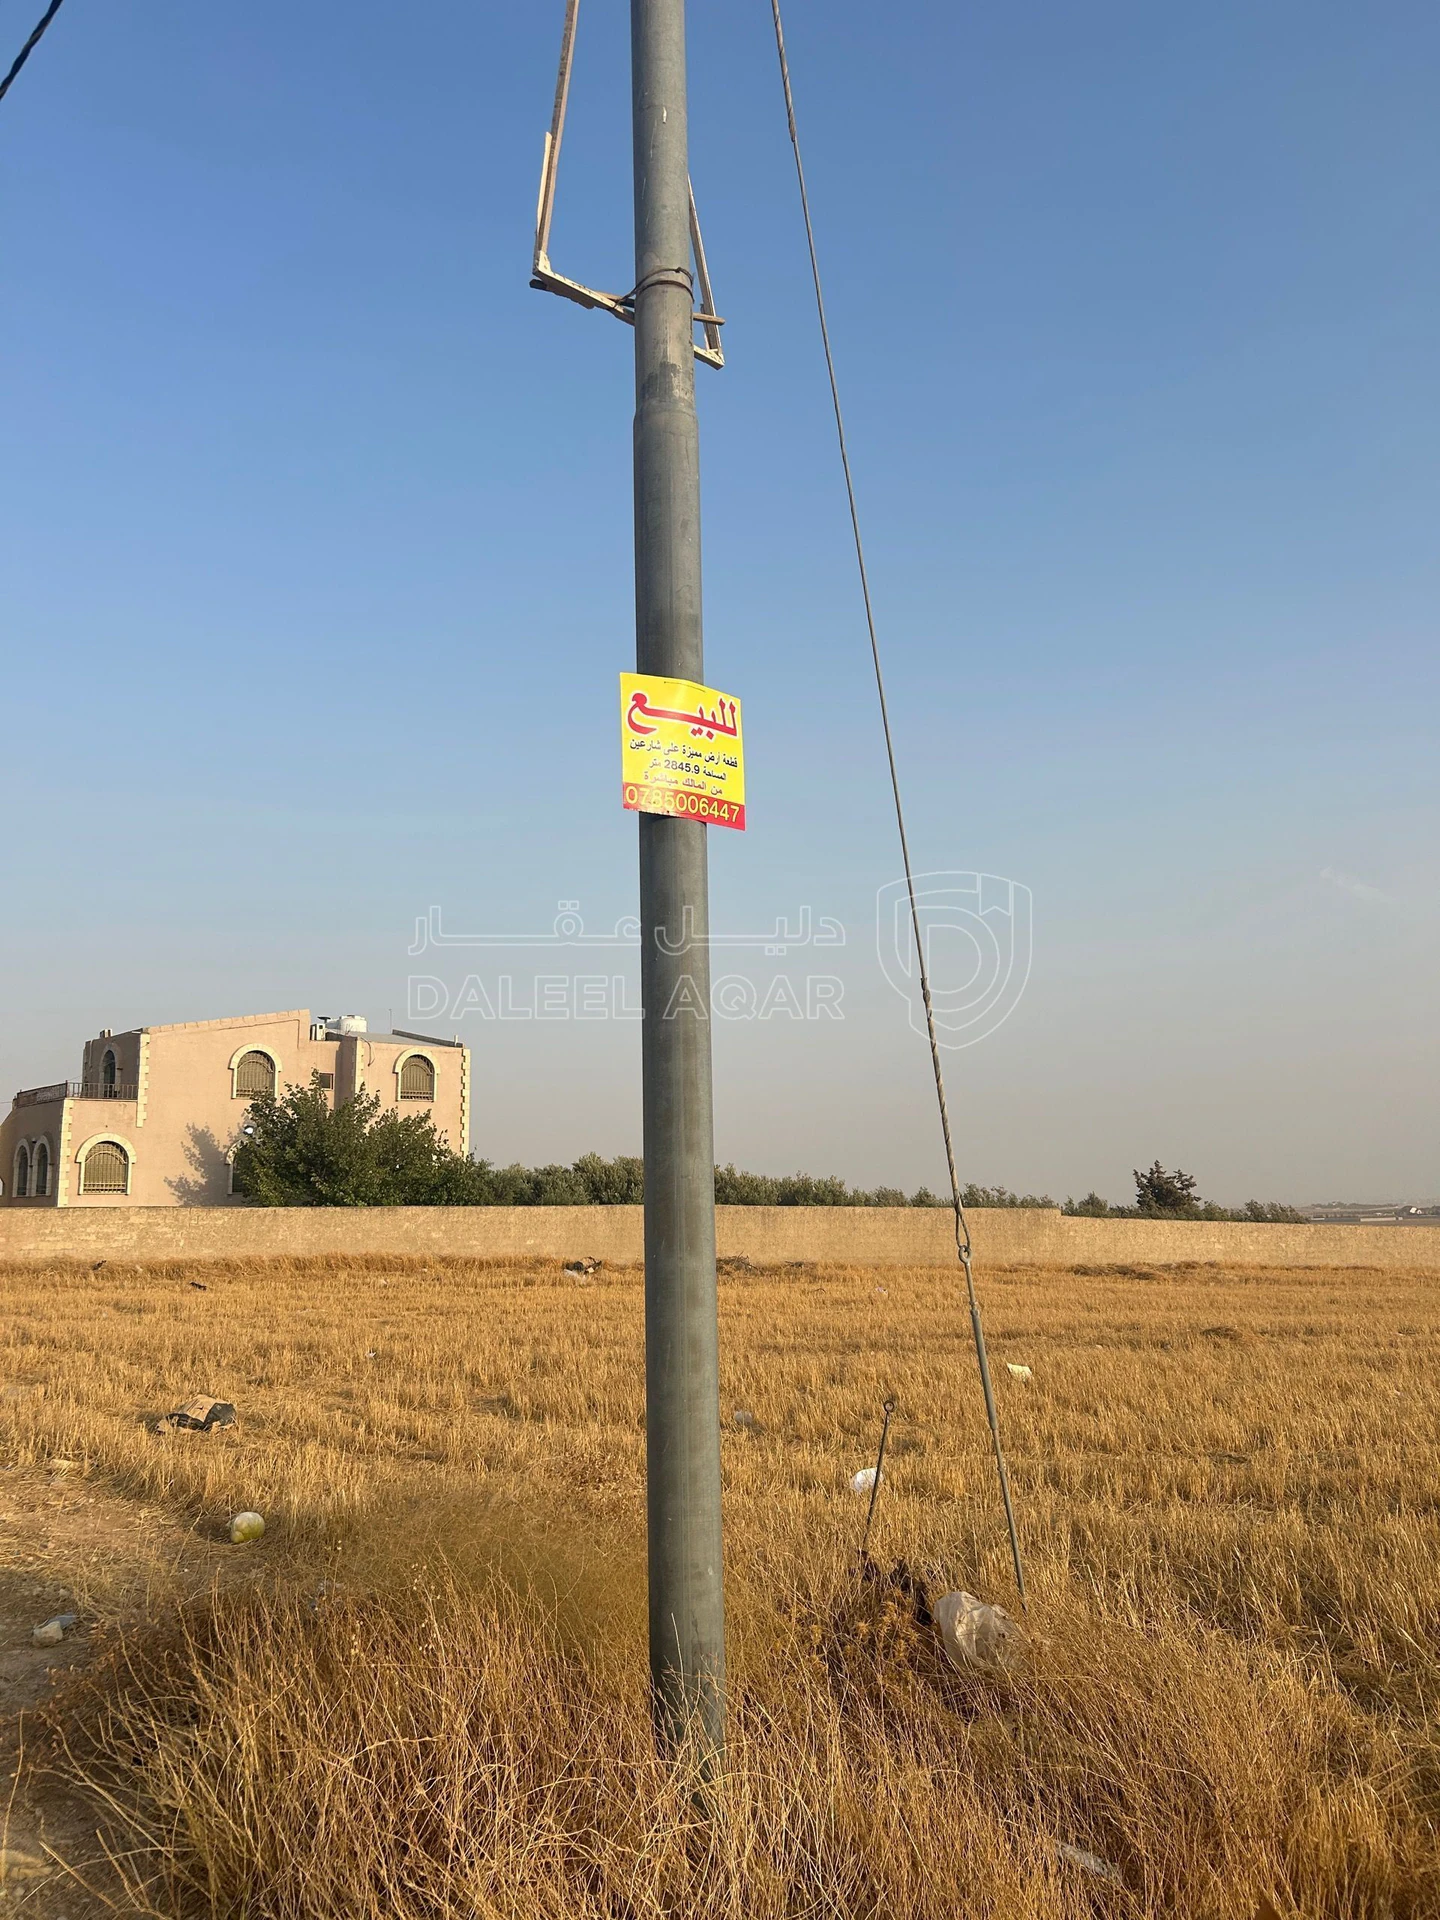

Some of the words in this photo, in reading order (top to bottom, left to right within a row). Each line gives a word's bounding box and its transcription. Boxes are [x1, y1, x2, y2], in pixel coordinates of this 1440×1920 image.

[627, 692, 738, 740] للبيع
[629, 738, 661, 752] شارعين
[663, 742, 679, 756] على
[682, 744, 702, 759] مميزة
[649, 758, 662, 769] متر
[664, 759, 700, 775] 2845.9
[723, 753, 738, 768] قطعة
[643, 770, 679, 786] مباشرة
[702, 765, 727, 780] المساحة
[682, 778, 707, 790] المالك
[710, 785, 723, 796] من
[625, 785, 740, 823] 0785006447
